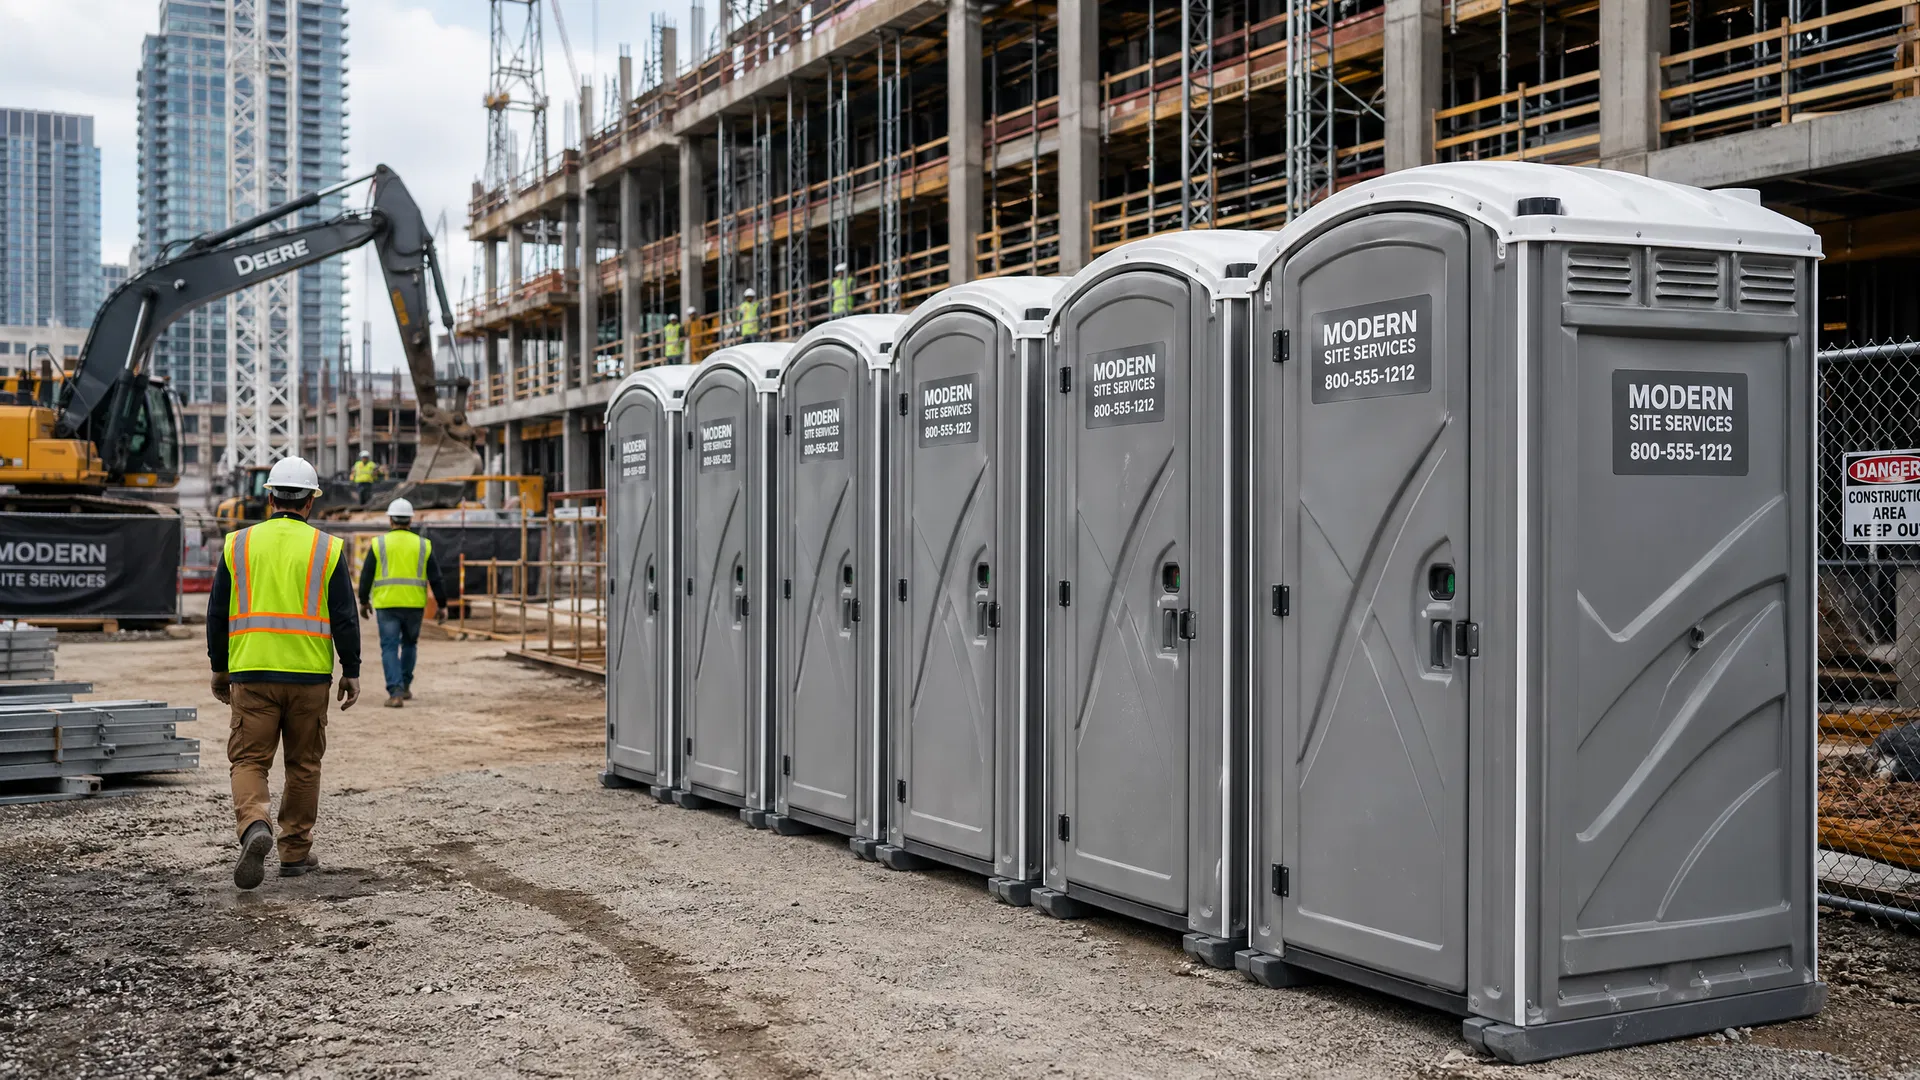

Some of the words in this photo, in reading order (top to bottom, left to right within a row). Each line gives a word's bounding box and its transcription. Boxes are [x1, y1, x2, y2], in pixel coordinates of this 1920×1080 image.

[233, 238, 310, 277] DEERE
[1323, 309, 1417, 347] MODERN
[1324, 347, 1351, 365] SITE
[1353, 338, 1417, 361] SERVICES
[1093, 354, 1156, 382] MODERN
[1325, 364, 1416, 390] 800-555-1212
[924, 383, 973, 406] MODERN
[1093, 383, 1112, 397] SITE
[1113, 377, 1156, 394] SERVICES
[1629, 383, 1734, 411] MODERN
[804, 407, 840, 428] MODERN
[924, 408, 939, 420] SITE
[940, 403, 973, 418] SERVICES
[1094, 398, 1155, 418] 800-555-1212
[703, 423, 732, 441] MODERN
[925, 421, 972, 439] 800-555-1212
[1629, 414, 1662, 431] SITE
[1665, 415, 1733, 432] SERVICES
[804, 429, 815, 439] SITE
[1630, 442, 1733, 461] 800-555-1212
[1857, 460, 1920, 479] DANGER
[1872, 506, 1907, 520] AREA
[1897, 523, 1920, 537] OU
[0, 542, 107, 564] MODERN
[0, 572, 26, 587] ITE
[29, 572, 107, 588] SERVICES
